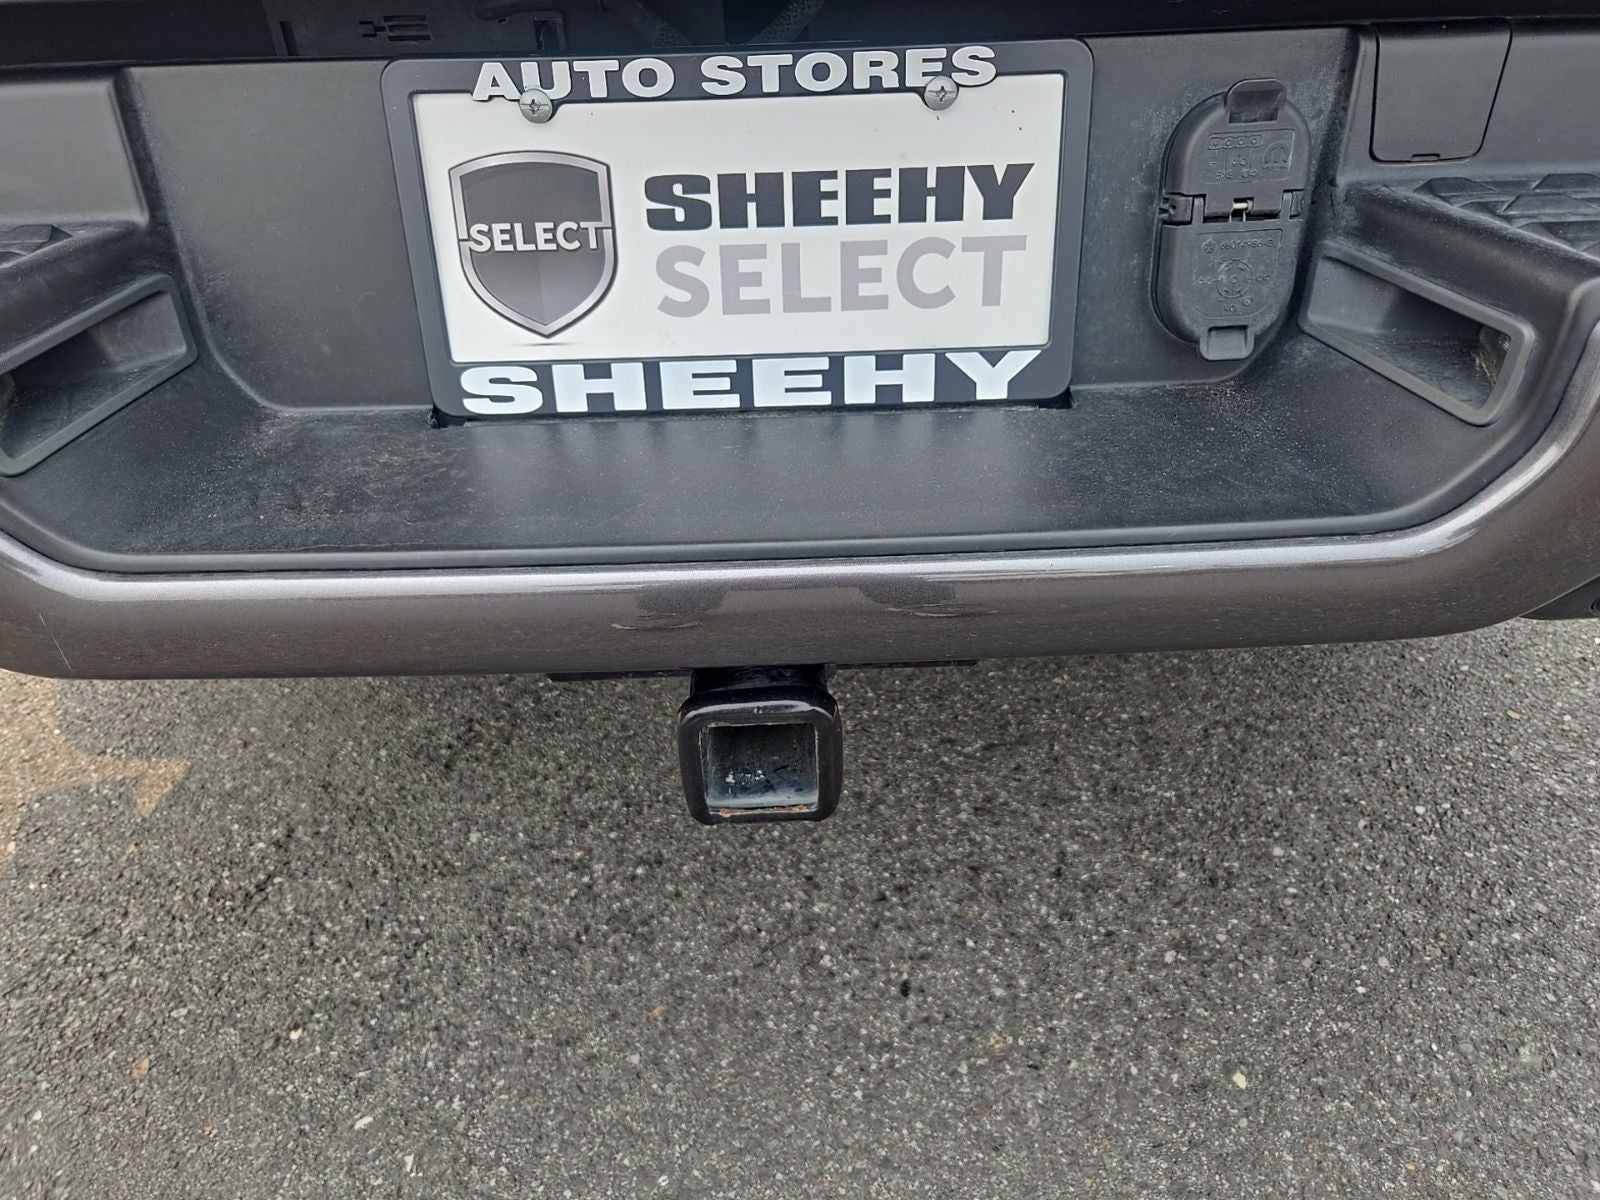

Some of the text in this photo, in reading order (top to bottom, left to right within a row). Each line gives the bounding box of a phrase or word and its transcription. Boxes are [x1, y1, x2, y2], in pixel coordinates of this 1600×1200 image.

[472, 45, 997, 101] AUTO STORES
[643, 163, 1036, 231] SHEEHY
[468, 220, 605, 253] SELECT
[655, 235, 1028, 318] SELECT
[460, 349, 1043, 416] SHEEHY
